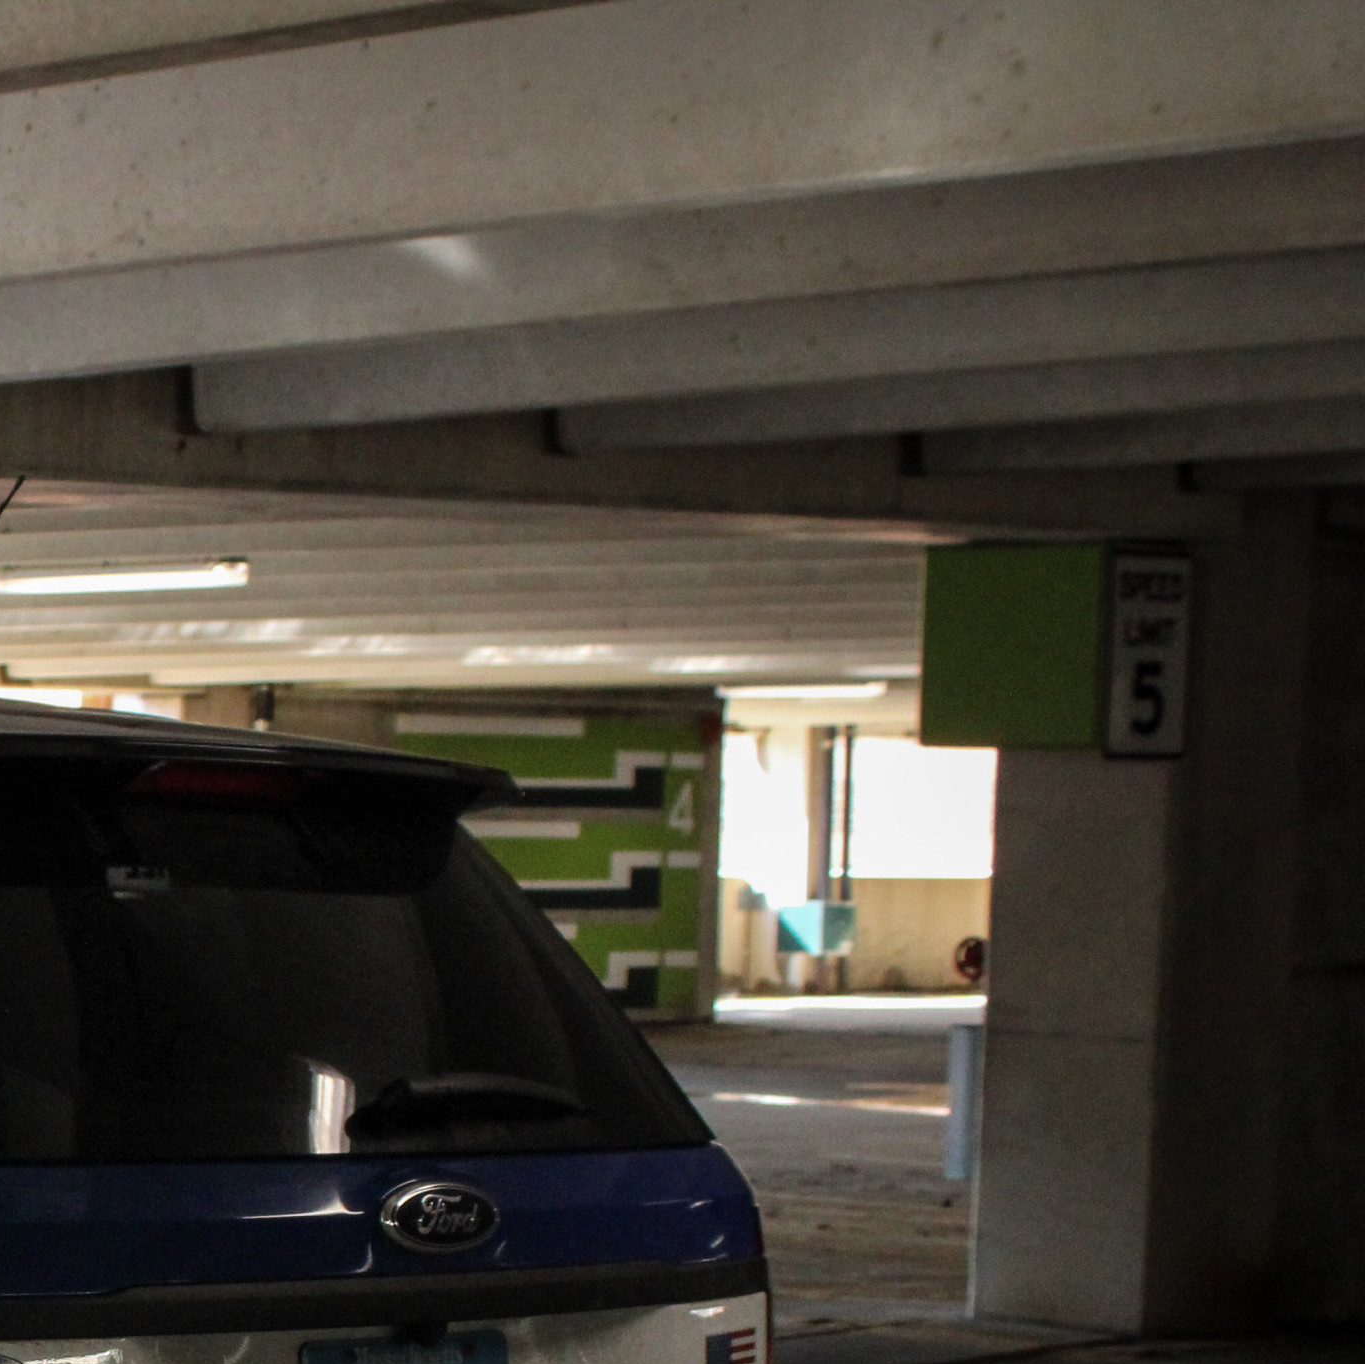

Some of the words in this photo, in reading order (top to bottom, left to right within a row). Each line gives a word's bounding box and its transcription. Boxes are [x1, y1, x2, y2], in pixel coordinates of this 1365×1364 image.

[1120, 571, 1184, 602] SPEED
[1124, 617, 1176, 646] LIMIT
[1131, 661, 1165, 735] 5
[669, 781, 693, 833] 4
[418, 1193, 479, 1234] Ford
